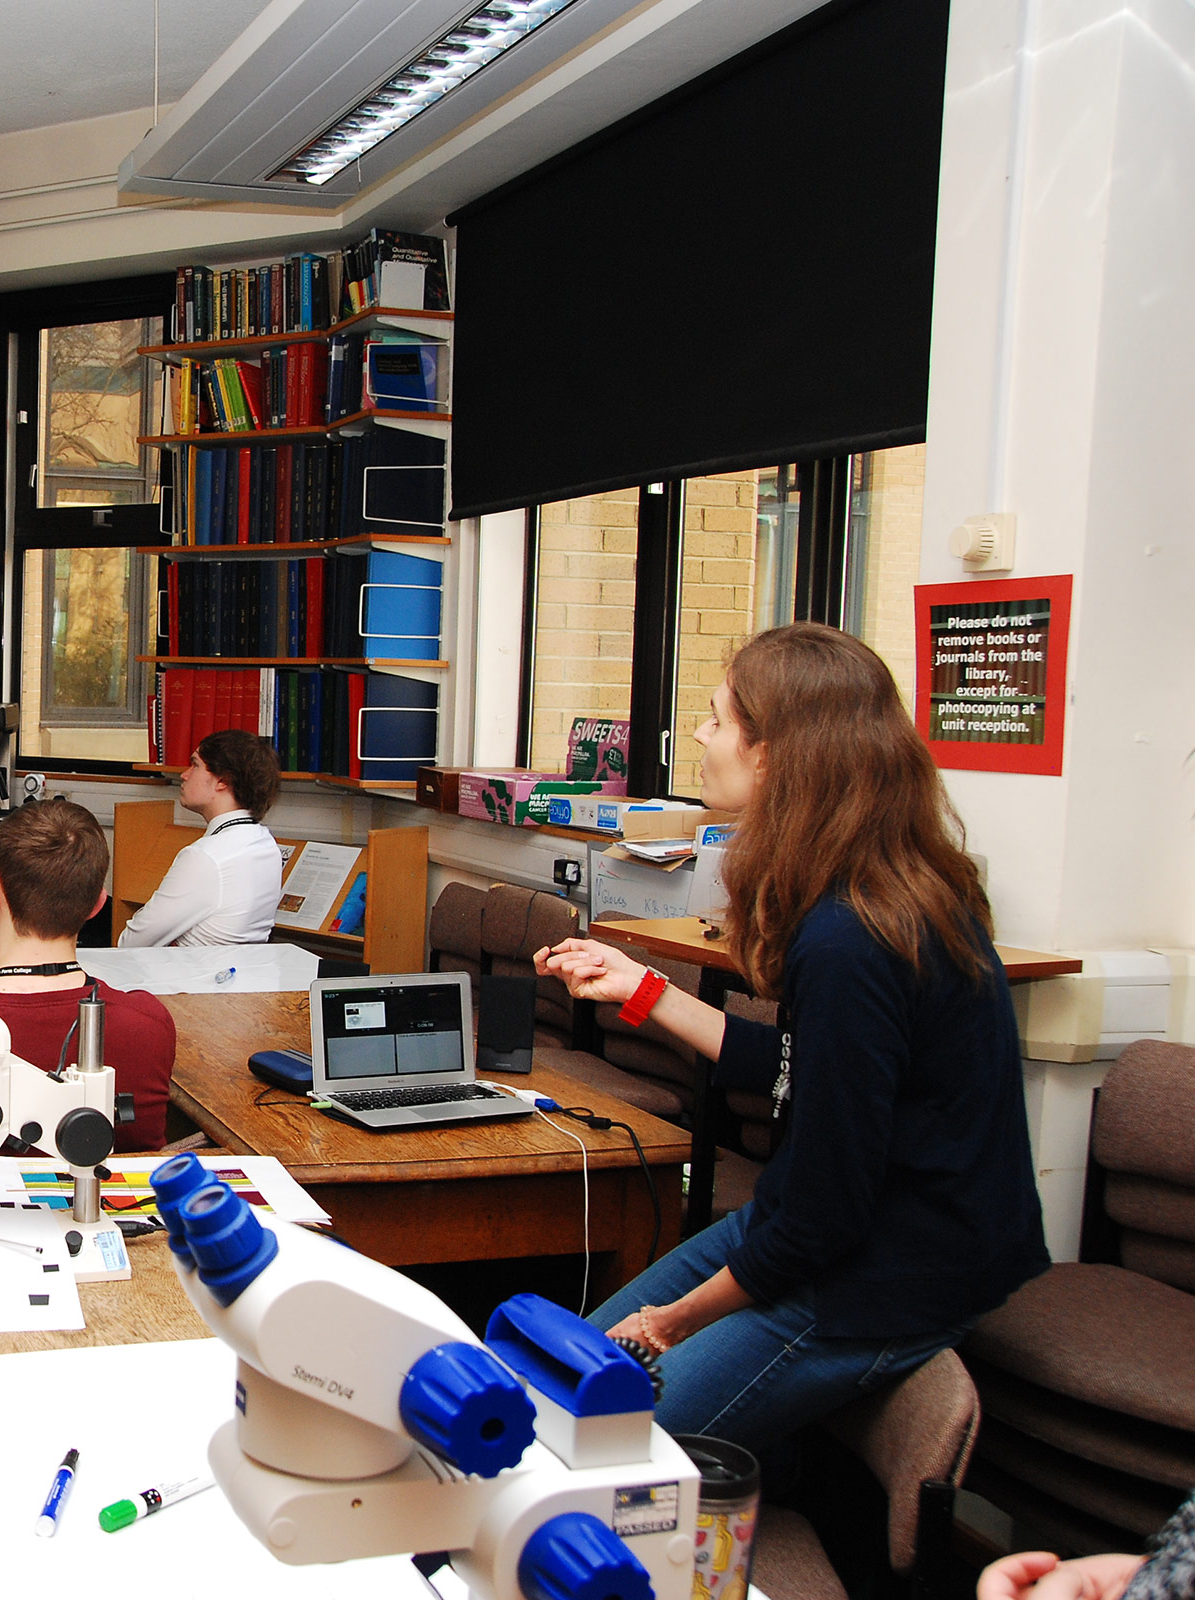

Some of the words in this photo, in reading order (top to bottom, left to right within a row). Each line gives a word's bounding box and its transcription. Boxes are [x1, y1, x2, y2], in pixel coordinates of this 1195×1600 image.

[947, 617, 989, 629] Please
[991, 615, 1008, 627] do
[1010, 614, 1033, 626] not
[938, 634, 984, 647] remove
[986, 632, 1025, 645] books
[1027, 633, 1042, 644] or
[935, 650, 986, 666] journals
[988, 650, 1019, 662] from
[1021, 649, 1043, 662] the
[965, 668, 1010, 682] library,
[956, 686, 997, 699] except
[999, 684, 1019, 697] for
[938, 701, 1020, 717] photocopying
[1021, 703, 1036, 715] at
[941, 719, 966, 731] unit
[967, 720, 1030, 734] reception.
[530, 793, 541, 801] WE
[292, 1365, 325, 1389] Stemi
[327, 1380, 355, 1400] DV4
[616, 1519, 674, 1535] PASSED
